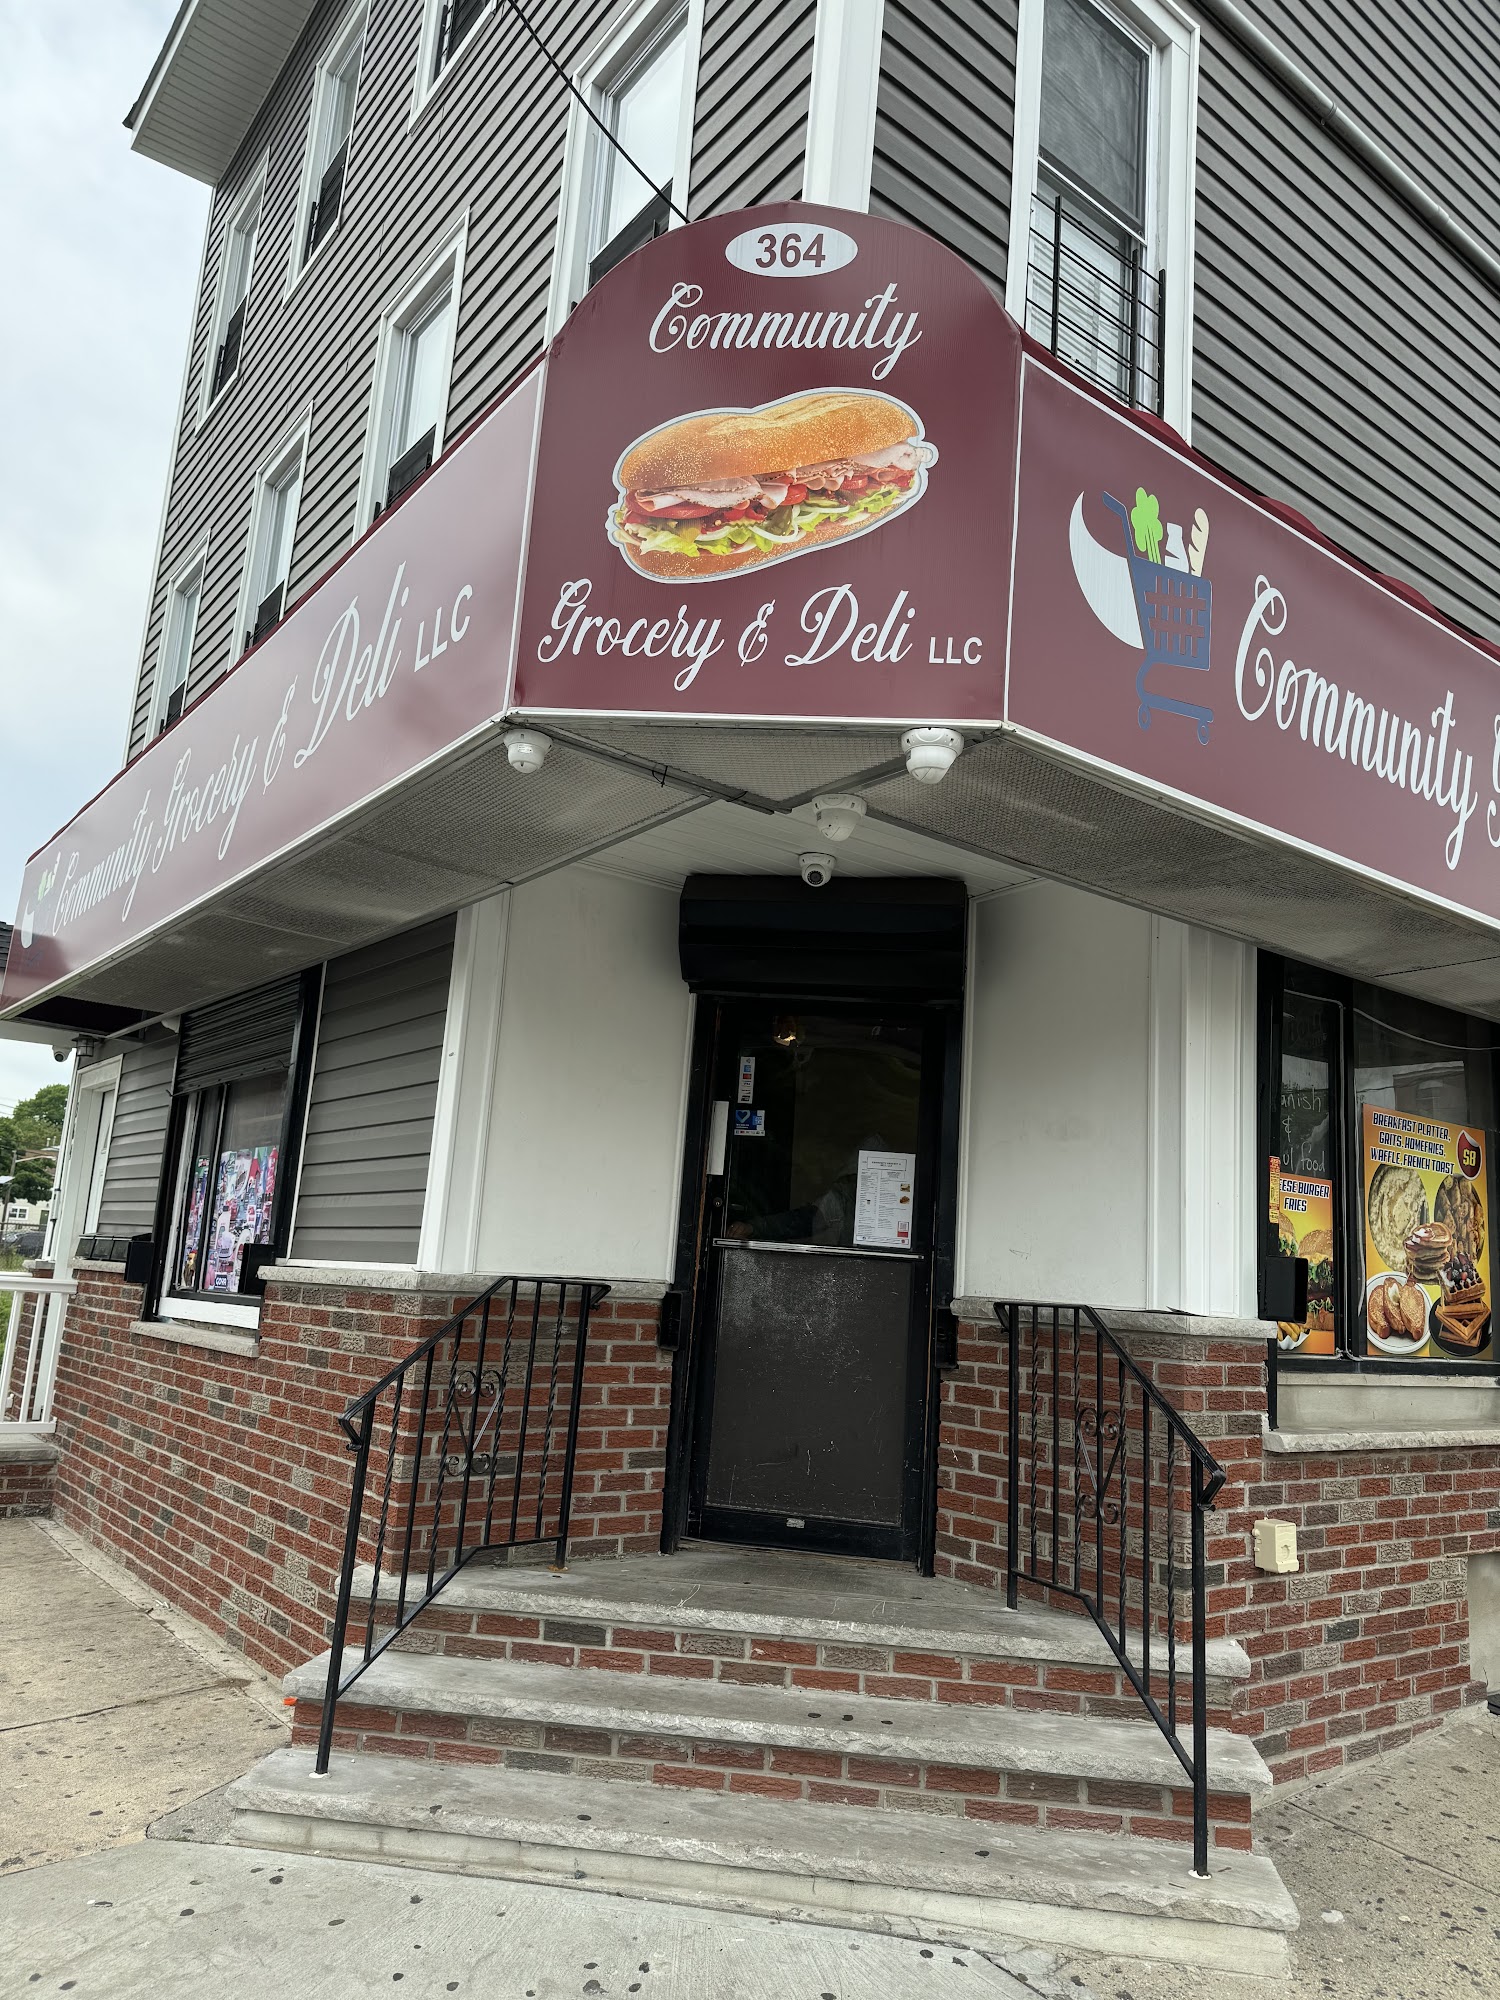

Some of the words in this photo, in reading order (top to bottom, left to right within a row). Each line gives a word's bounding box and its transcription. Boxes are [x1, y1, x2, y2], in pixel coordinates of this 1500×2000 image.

[755, 233, 826, 268] 364
[648, 282, 923, 381] Community
[537, 578, 725, 692] Grocery
[737, 599, 776, 667] &
[784, 583, 916, 667] Deli
[928, 636, 983, 665] LLC
[1235, 574, 1478, 871] Community
[53, 788, 154, 937] Community
[152, 733, 259, 874] Grocery
[262, 675, 299, 796] &
[293, 561, 411, 769] Deli
[413, 584, 474, 673] LLC
[1280, 1088, 1321, 1112] anish
[1373, 1112, 1417, 1133] BREAKFAST
[1300, 1141, 1326, 1172] food
[1403, 1154, 1430, 1171] FRENCH
[1431, 1159, 1455, 1175] TOAST
[1463, 1149, 1476, 1167] $8
[1297, 1181, 1330, 1199] BURGER
[1284, 1197, 1307, 1213] FRIES
